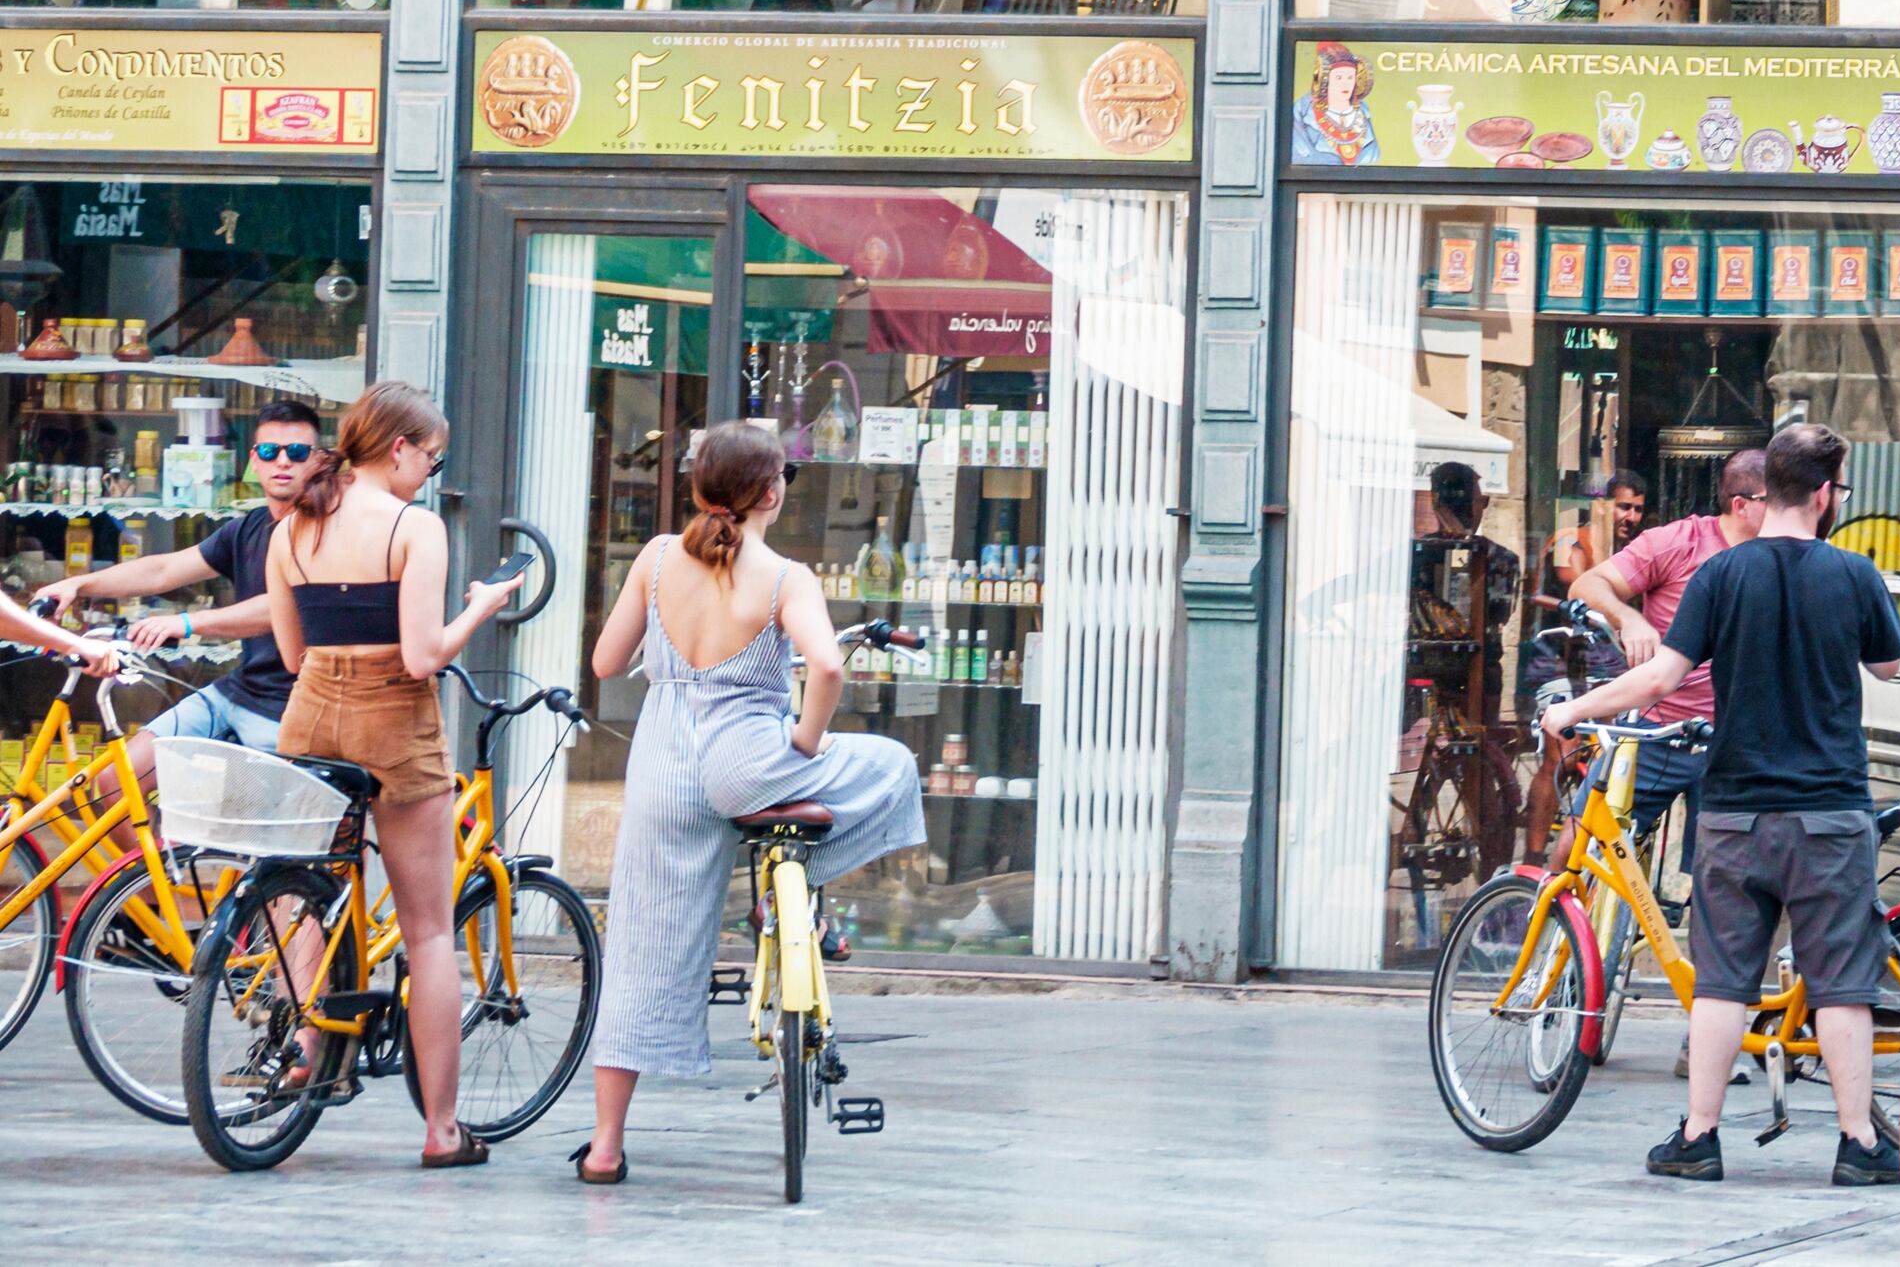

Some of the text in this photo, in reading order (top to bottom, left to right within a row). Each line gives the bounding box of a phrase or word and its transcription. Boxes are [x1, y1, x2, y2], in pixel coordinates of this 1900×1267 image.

[652, 36, 1008, 49] COMERCIO GLOBAL DE ARTESANÍA TRADICIONAL
[13, 49, 34, 75] Y
[45, 33, 285, 81] CONDIMENTOS
[1377, 48, 1523, 74] CERÁMICA
[1528, 53, 1680, 76] ARTESANA
[1686, 56, 1740, 77] DEL
[57, 84, 166, 103] Canela de Ceylan
[615, 48, 1039, 138] Fenitzia
[52, 105, 172, 120] Piñones de Castilla
